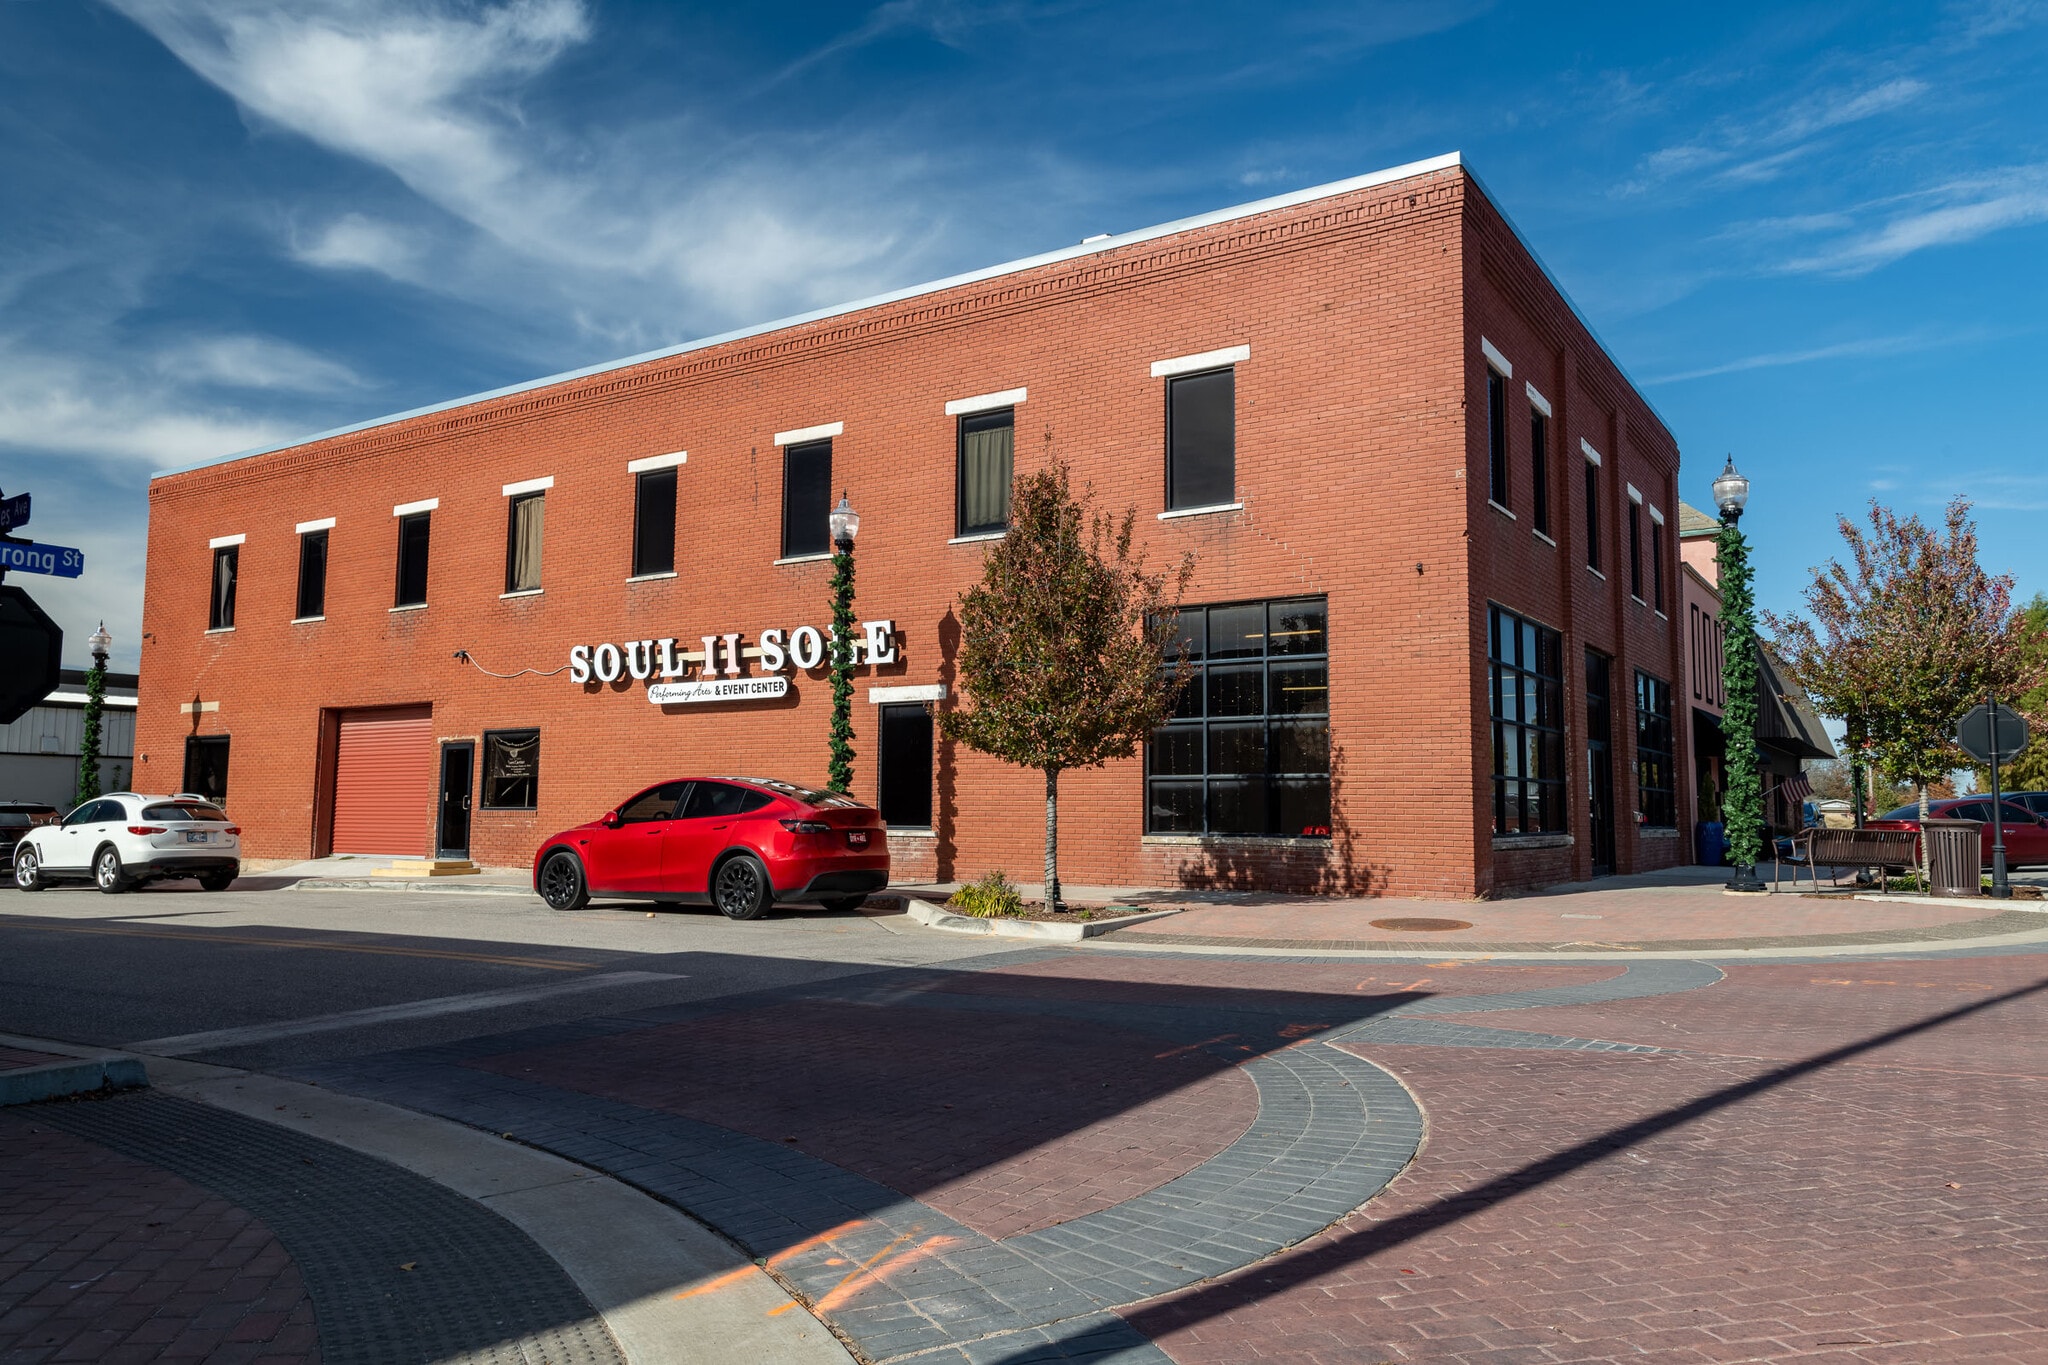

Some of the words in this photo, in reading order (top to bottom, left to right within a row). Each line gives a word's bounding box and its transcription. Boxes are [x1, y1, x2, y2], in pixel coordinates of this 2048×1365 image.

[14, 500, 28, 516] Ave
[0, 546, 55, 575] rong
[62, 550, 80, 568] St
[570, 638, 686, 683] SOUL
[701, 633, 742, 675] II
[650, 685, 692, 701] Performing
[692, 682, 712, 696] Arts
[715, 685, 721, 696] &
[723, 683, 749, 695] EVENT
[751, 681, 785, 693] CENTER
